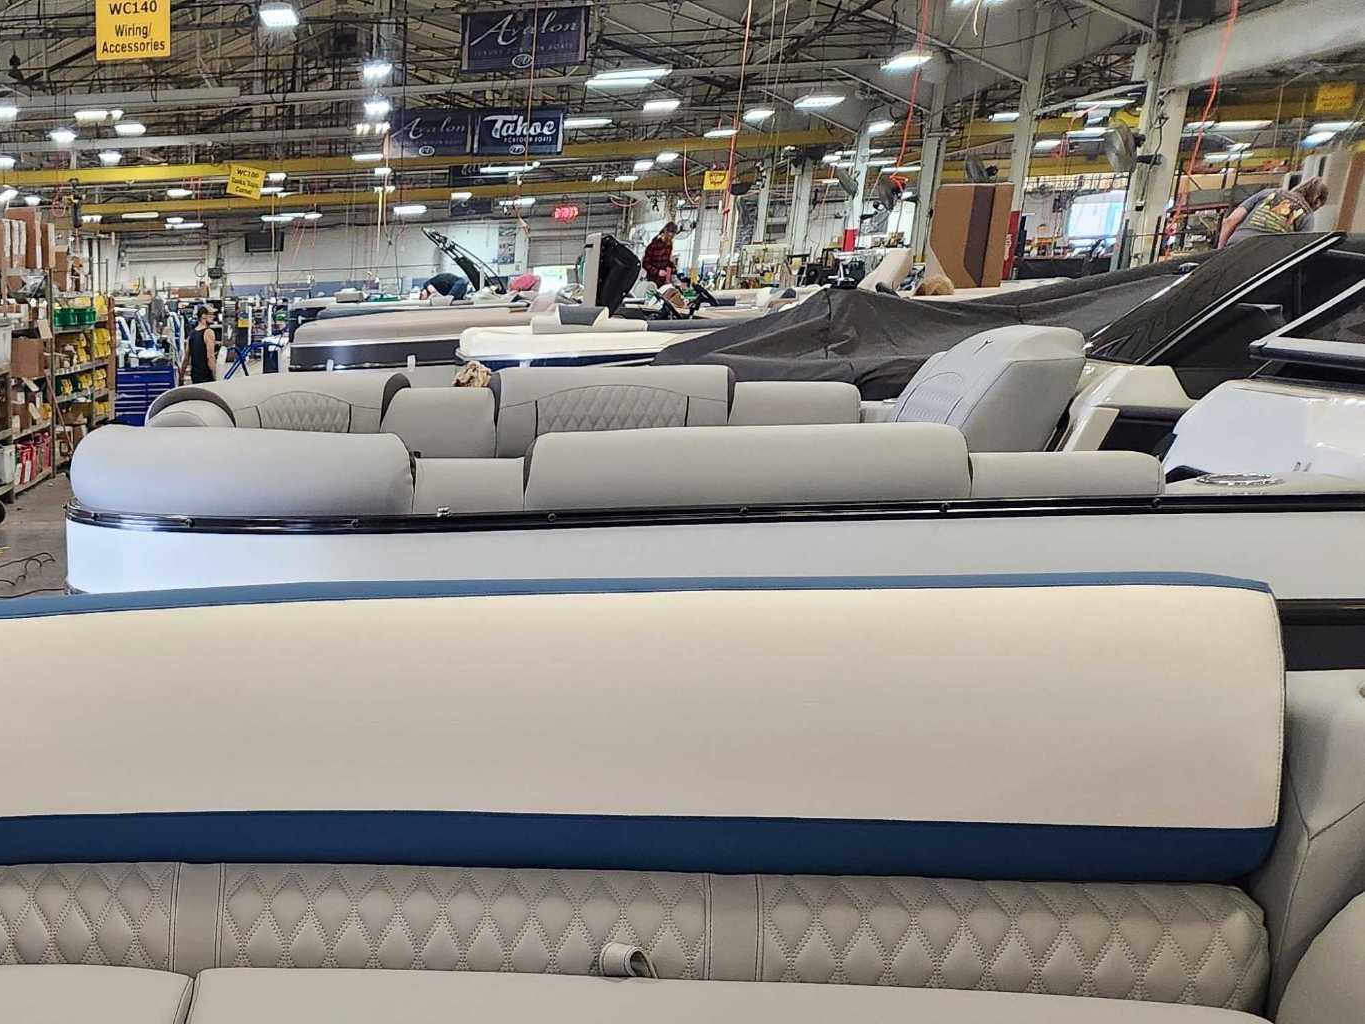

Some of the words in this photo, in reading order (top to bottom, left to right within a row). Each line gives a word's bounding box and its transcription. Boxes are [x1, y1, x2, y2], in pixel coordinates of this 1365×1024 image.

[109, 1, 157, 15] WC140
[469, 9, 579, 46] Avalon
[101, 38, 166, 54] Accessories
[483, 114, 557, 139] Tahoe
